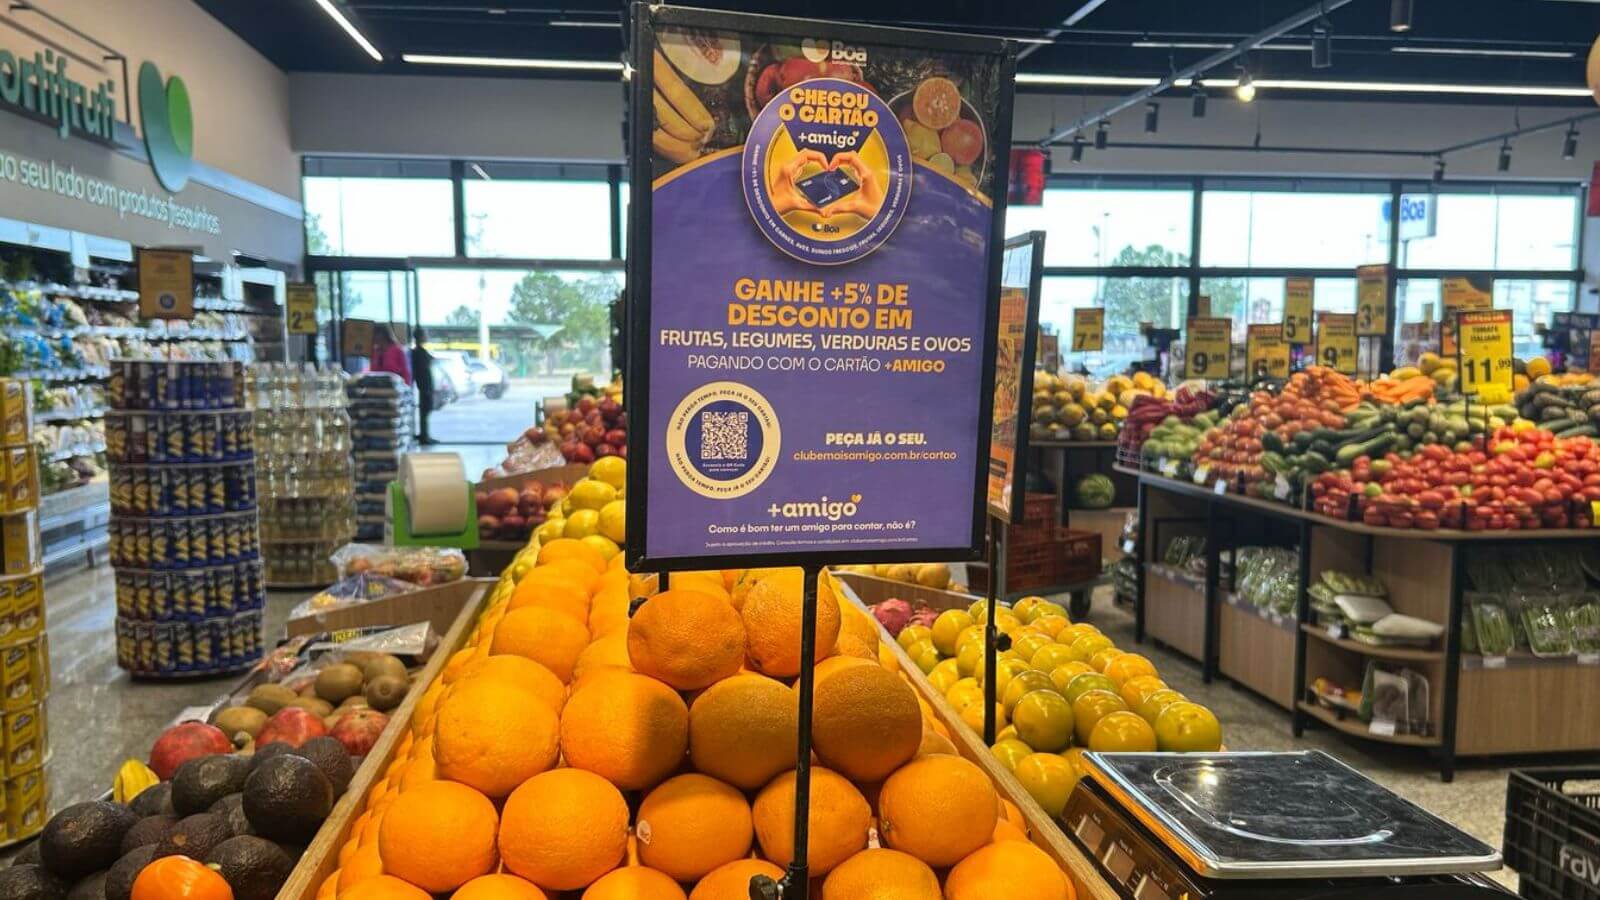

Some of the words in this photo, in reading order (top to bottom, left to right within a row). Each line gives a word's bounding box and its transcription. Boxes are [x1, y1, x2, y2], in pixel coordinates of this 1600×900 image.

[832, 40, 867, 60] Boa
[790, 88, 869, 110] CHEGOU
[779, 103, 796, 122] O
[799, 106, 879, 128] CARTÃO
[20, 160, 50, 190] seu
[51, 159, 84, 200] lado
[87, 180, 118, 210] com
[735, 278, 824, 303] GANHE
[831, 282, 872, 305] +5%
[877, 284, 909, 306] DE
[728, 303, 870, 329] DESCONTO
[875, 308, 912, 330] EM
[660, 330, 728, 349] FRUTAS,
[732, 332, 816, 351] LEGUMES,
[821, 334, 908, 351] VERDURAS
[912, 336, 920, 350] E
[924, 338, 971, 352] OVOS
[688, 355, 764, 370] PAGANDO
[768, 356, 805, 370] COM
[808, 358, 822, 371] O
[824, 356, 881, 372] CARTÃO
[884, 360, 946, 373] +AMIGO
[825, 432, 864, 448] PEÇA
[884, 433, 896, 444] O
[898, 432, 927, 444] SEU.
[768, 496, 858, 520] +amigo
[708, 524, 738, 534] Como
[740, 524, 746, 533] é
[748, 524, 770, 533] bom
[770, 524, 782, 532] ter
[784, 524, 800, 532] um
[801, 523, 830, 533] amigo
[832, 524, 852, 532] para
[854, 522, 885, 531] contar,
[886, 520, 904, 530] não
[905, 520, 916, 530] é?
